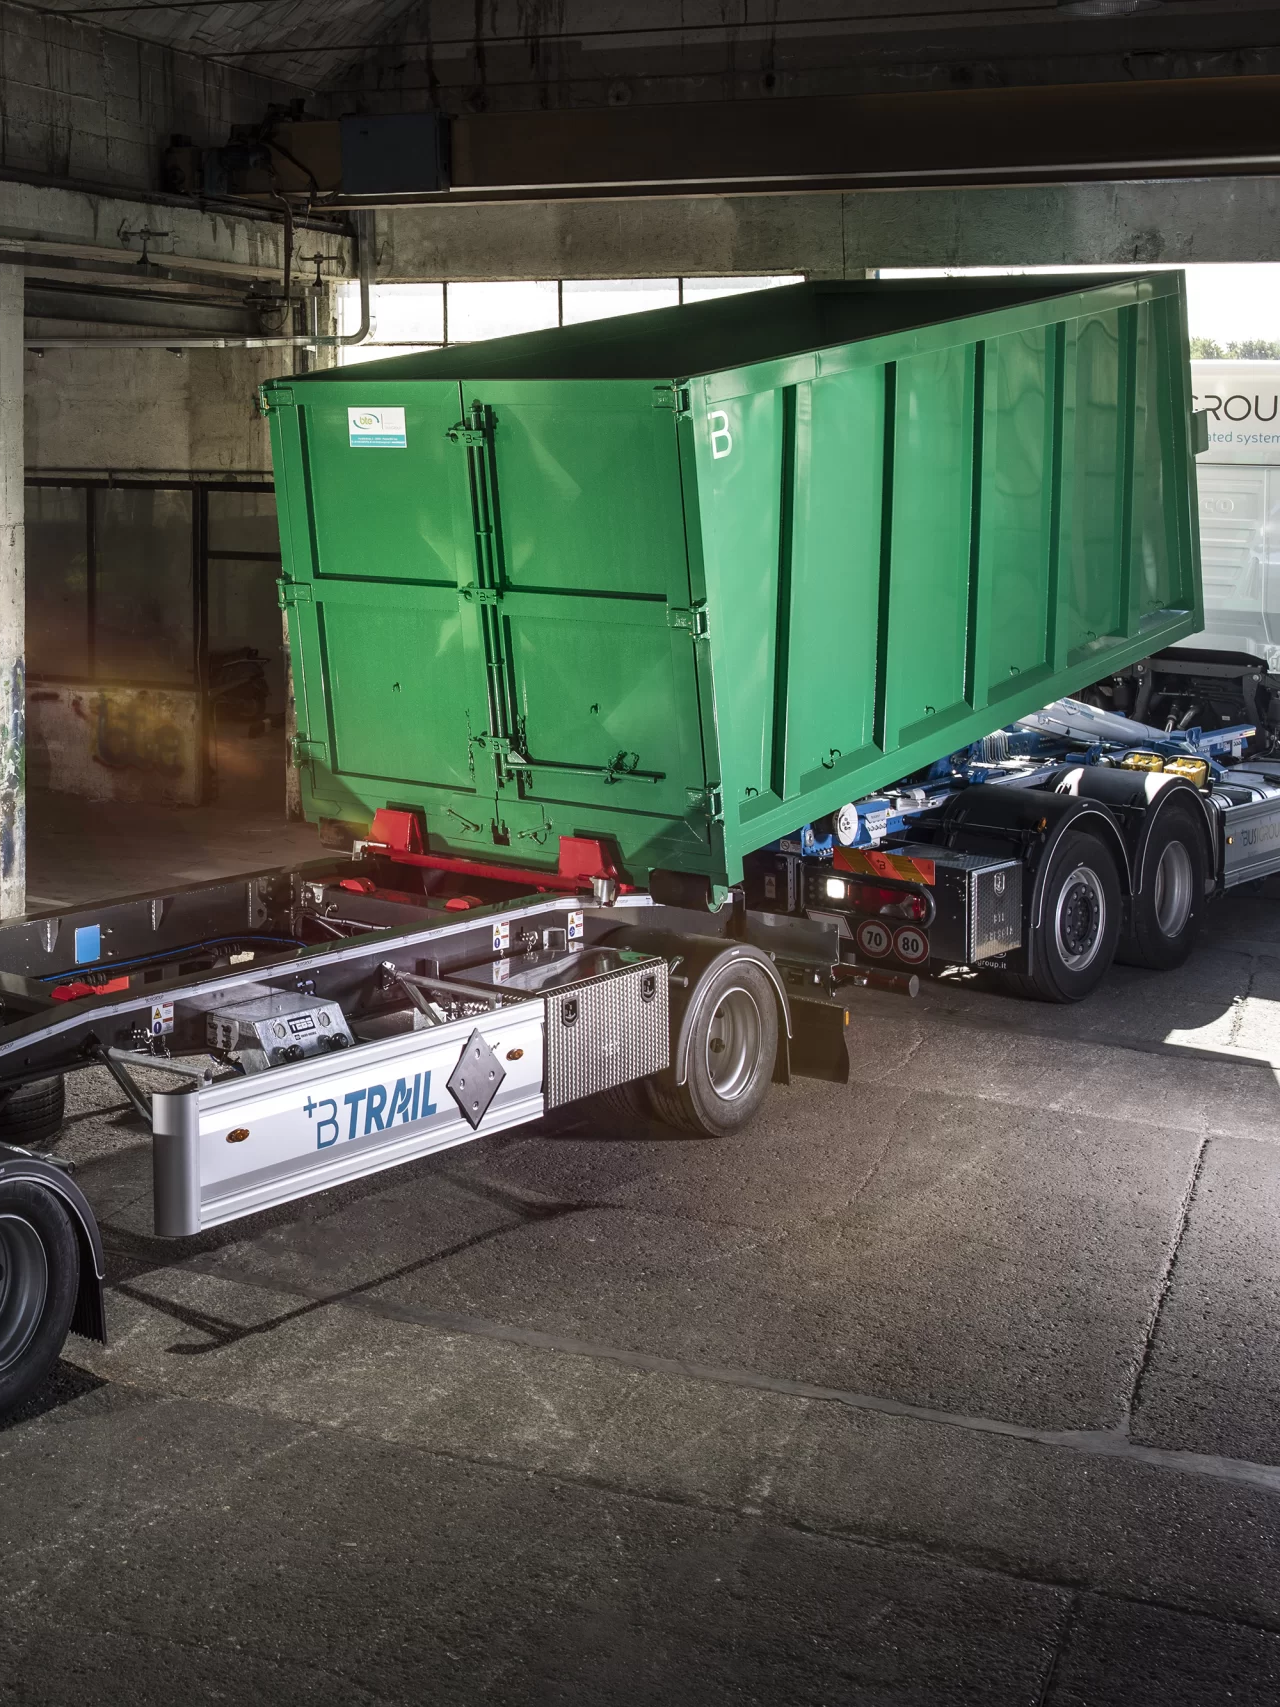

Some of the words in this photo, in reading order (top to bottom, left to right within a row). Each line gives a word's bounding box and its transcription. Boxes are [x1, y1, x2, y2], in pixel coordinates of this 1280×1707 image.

[1192, 395, 1278, 421] ROU
[866, 930, 883, 947] 70
[902, 936, 919, 953] 80
[344, 1070, 437, 1140] TRAIL
